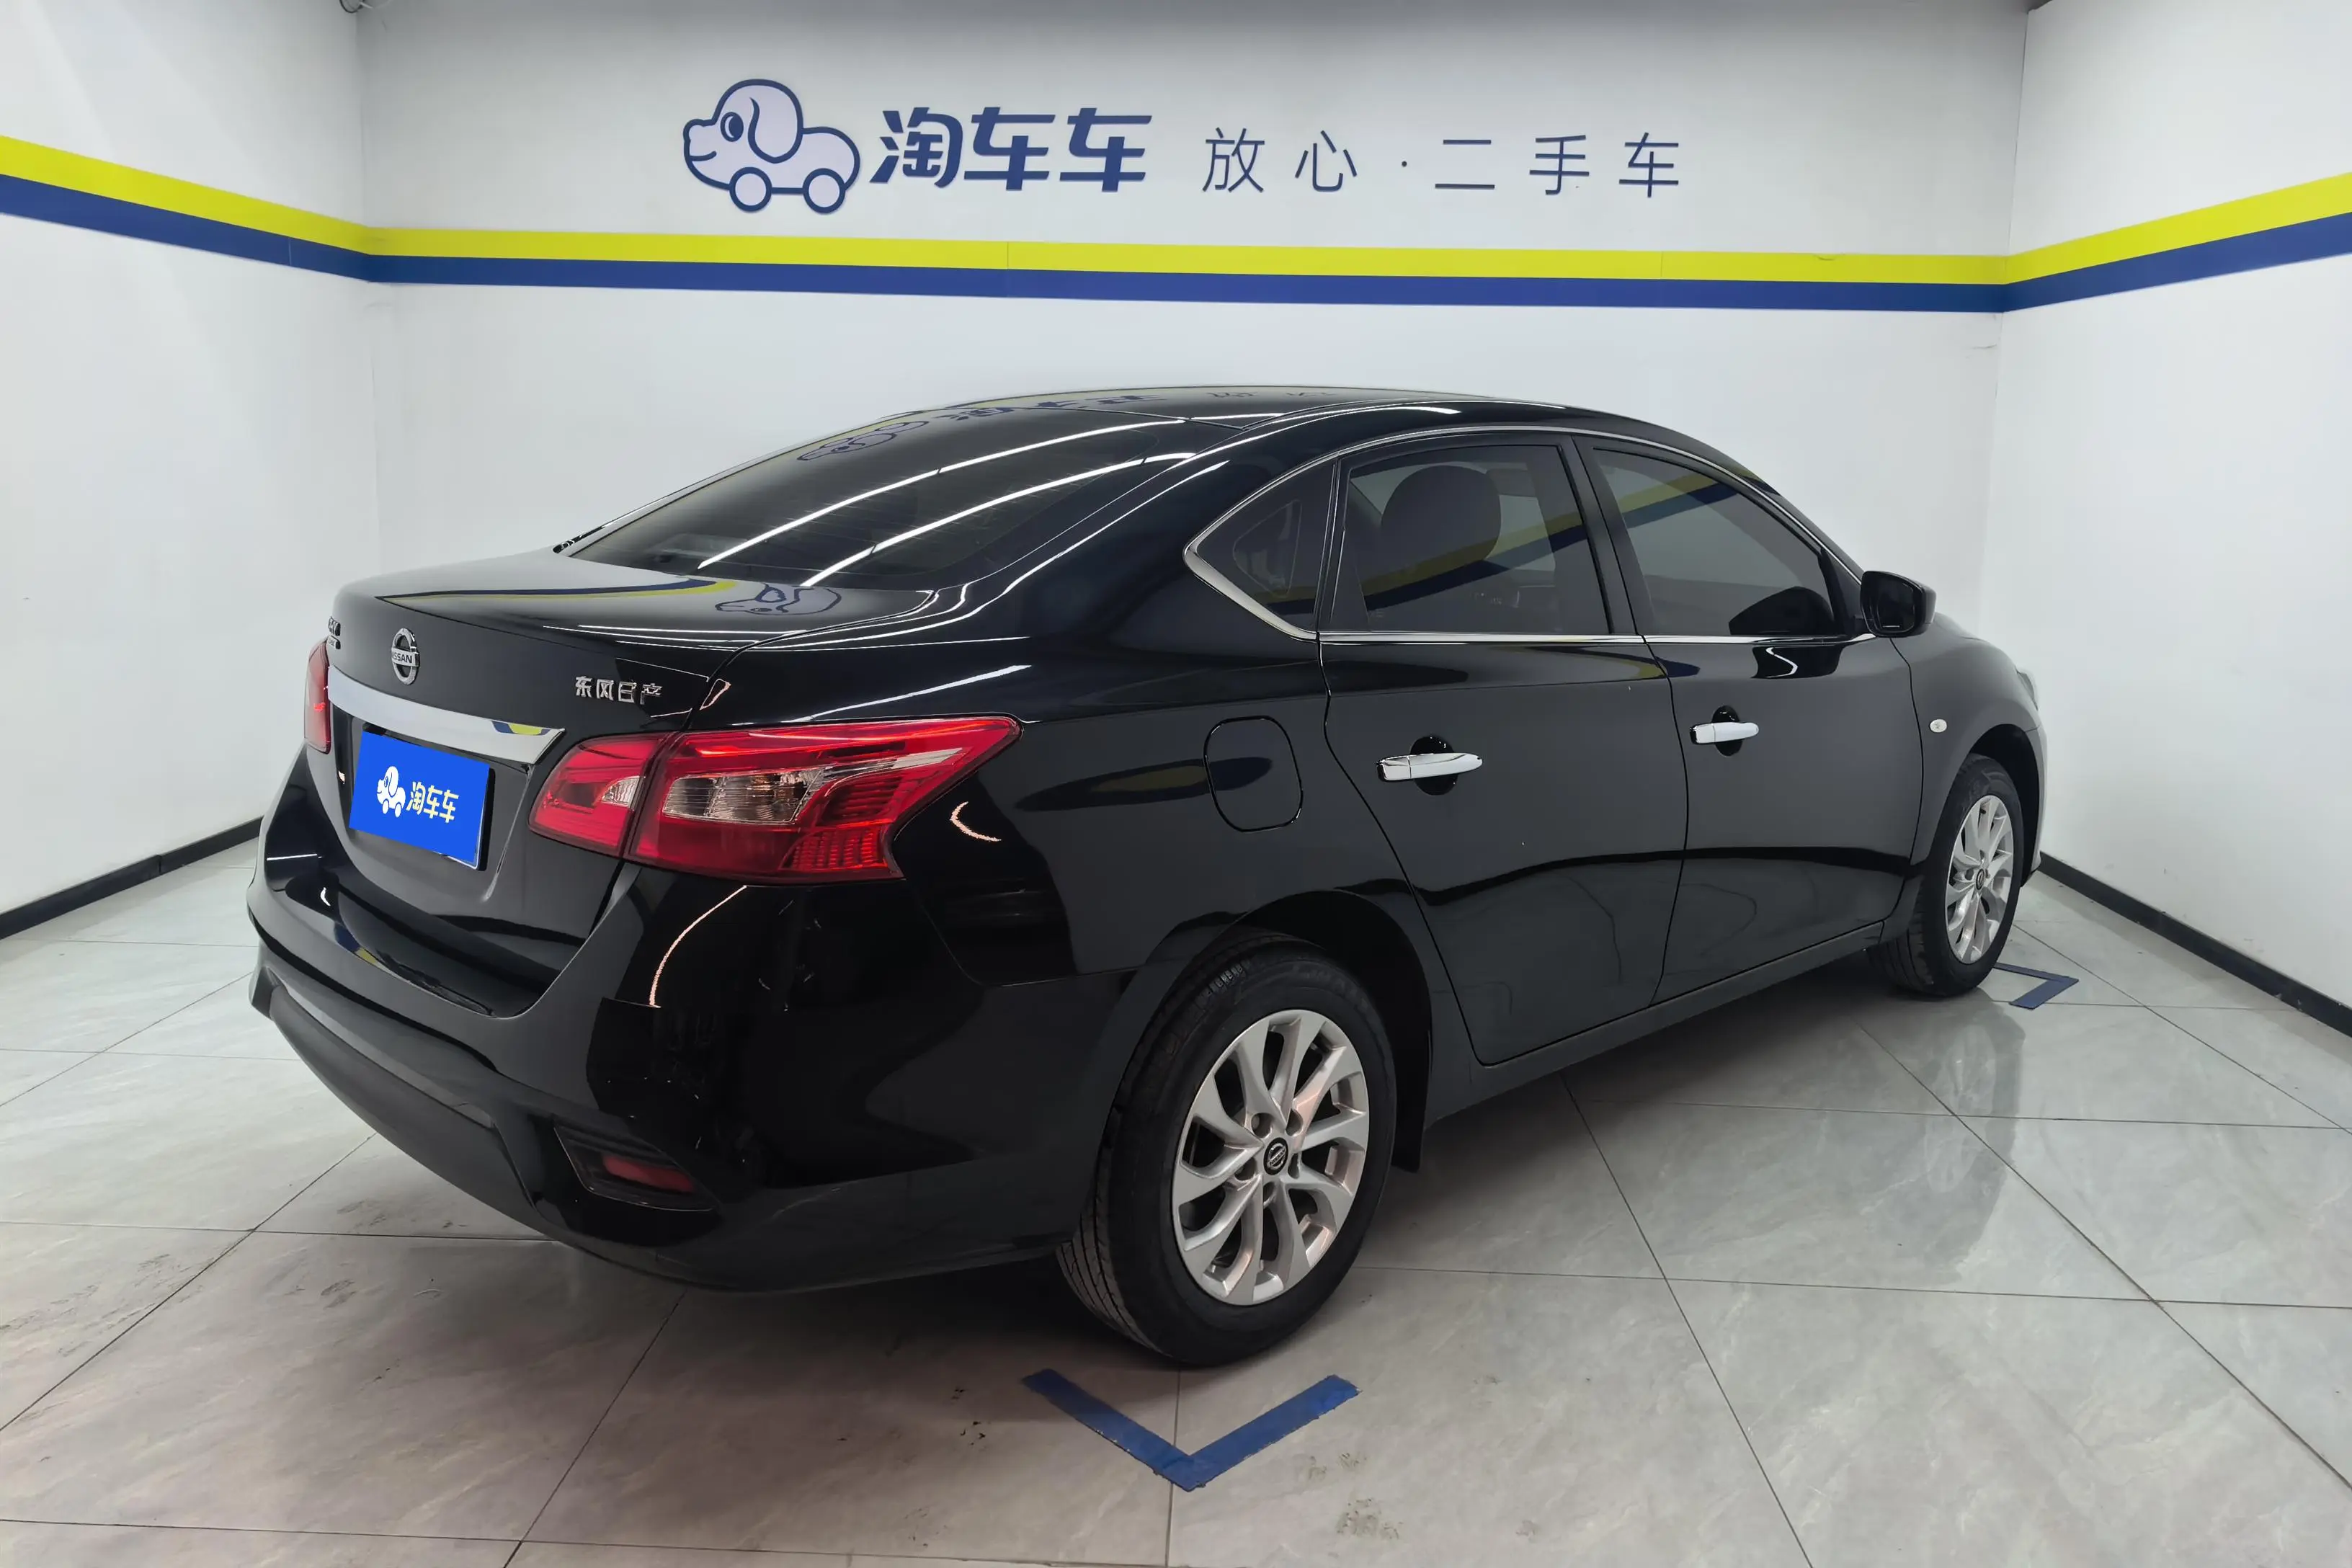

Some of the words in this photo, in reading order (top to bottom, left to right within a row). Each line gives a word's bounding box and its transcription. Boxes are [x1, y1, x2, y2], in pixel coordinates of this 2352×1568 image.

[869, 107, 1153, 192] 淘车车
[392, 651, 413, 664] SSAN
[575, 675, 663, 705] 东风日产
